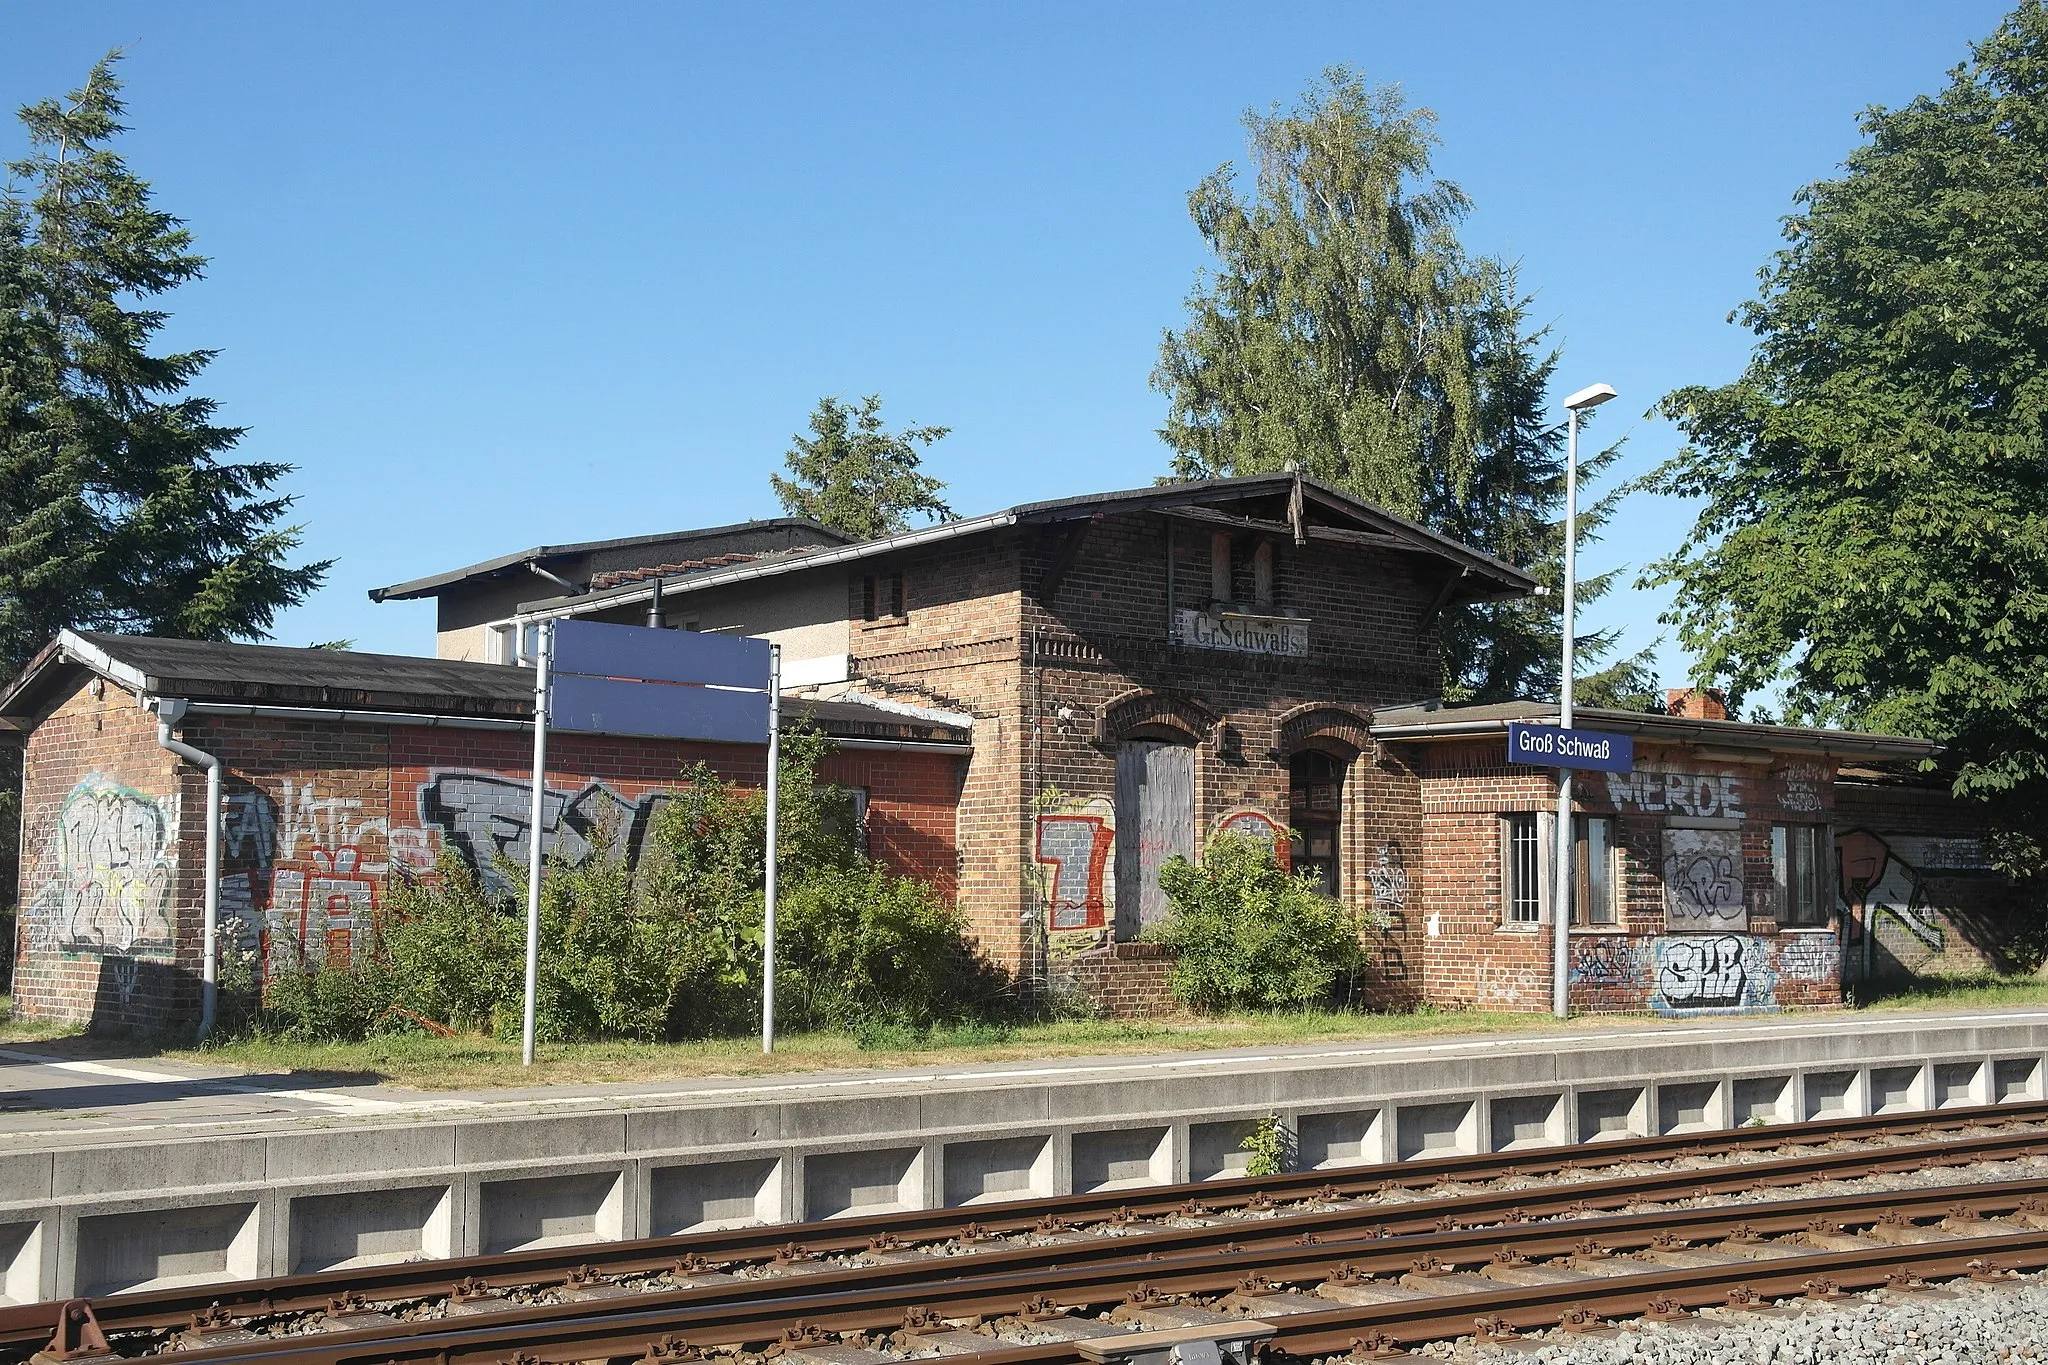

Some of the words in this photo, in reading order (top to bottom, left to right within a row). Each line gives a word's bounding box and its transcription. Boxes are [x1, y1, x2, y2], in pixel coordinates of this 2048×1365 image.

[1520, 730, 1553, 753] Groß
[1557, 734, 1610, 759] Schwaß
[1606, 770, 1747, 819] MERDE
